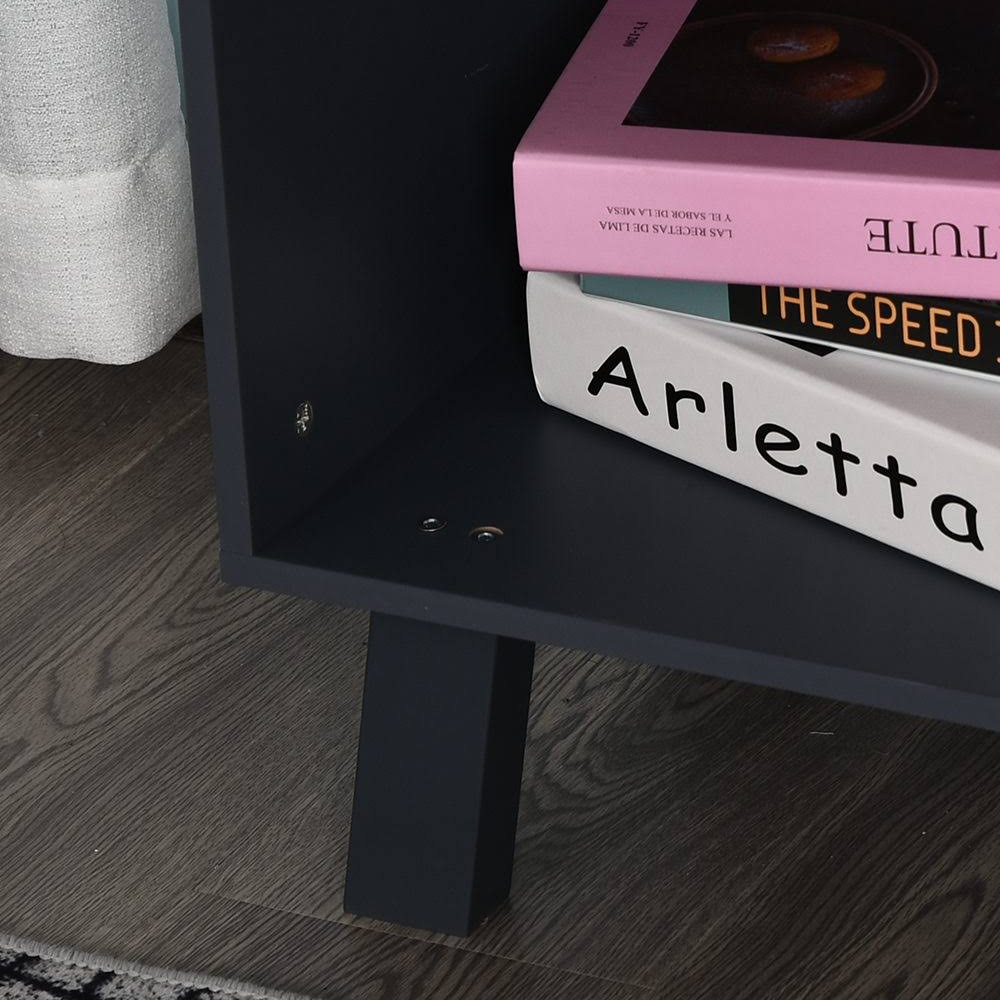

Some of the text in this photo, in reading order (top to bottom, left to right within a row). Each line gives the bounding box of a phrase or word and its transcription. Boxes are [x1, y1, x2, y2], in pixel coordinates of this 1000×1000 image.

[598, 220, 733, 238] LAS RECETAS DE LIMA
[606, 205, 732, 222] Y EL SABOR DE LA MESA
[847, 292, 981, 358] SPEED
[587, 345, 984, 551] Arletta
